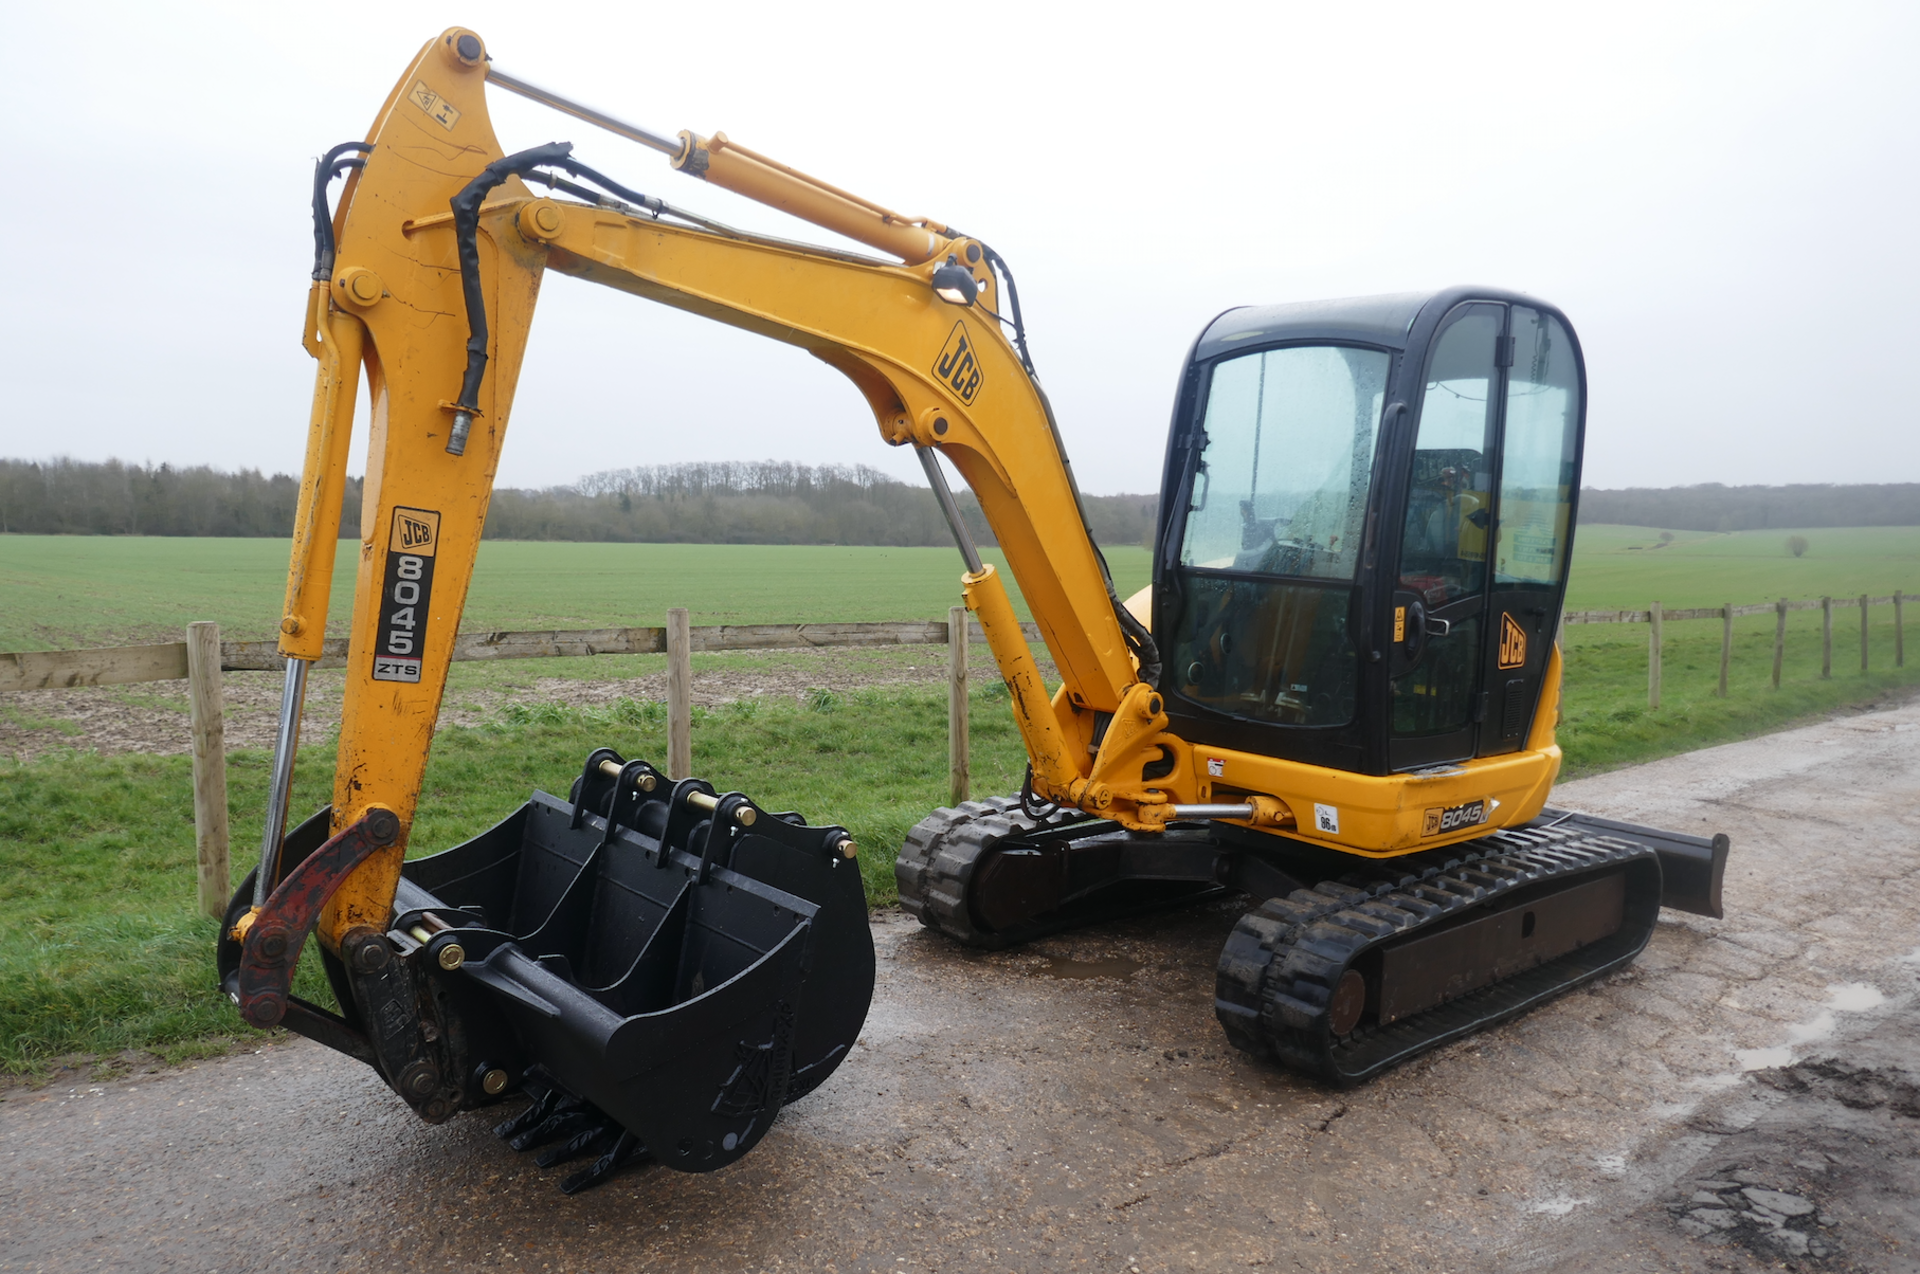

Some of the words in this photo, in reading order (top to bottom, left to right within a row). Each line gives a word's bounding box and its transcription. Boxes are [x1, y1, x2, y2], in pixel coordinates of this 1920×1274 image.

[938, 335, 980, 400] JCB
[403, 519, 430, 545] JCB
[388, 556, 424, 655] 8045
[1501, 621, 1523, 664] JCB
[378, 663, 417, 675] ZTS
[1426, 815, 1438, 831] JCB
[1440, 804, 1483, 829] 8045
